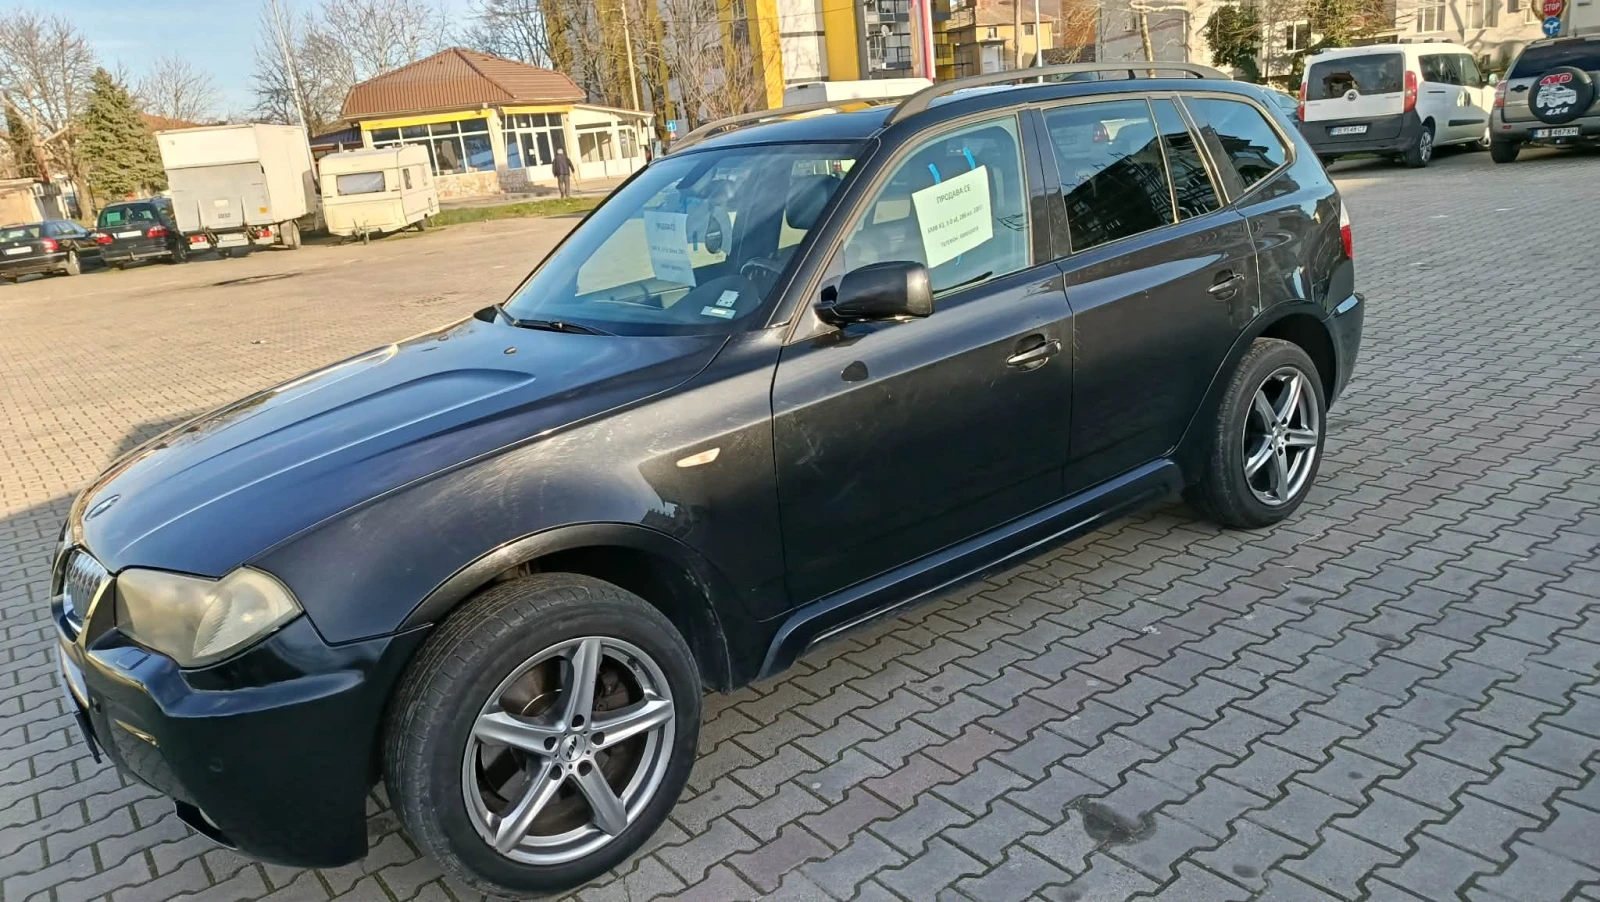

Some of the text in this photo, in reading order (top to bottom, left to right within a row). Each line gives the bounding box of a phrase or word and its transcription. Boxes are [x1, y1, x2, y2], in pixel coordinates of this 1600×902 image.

[1544, 3, 1560, 12] STOP
[1540, 72, 1572, 86] 4WD
[936, 184, 971, 204] ПРОДАВА СЕ
